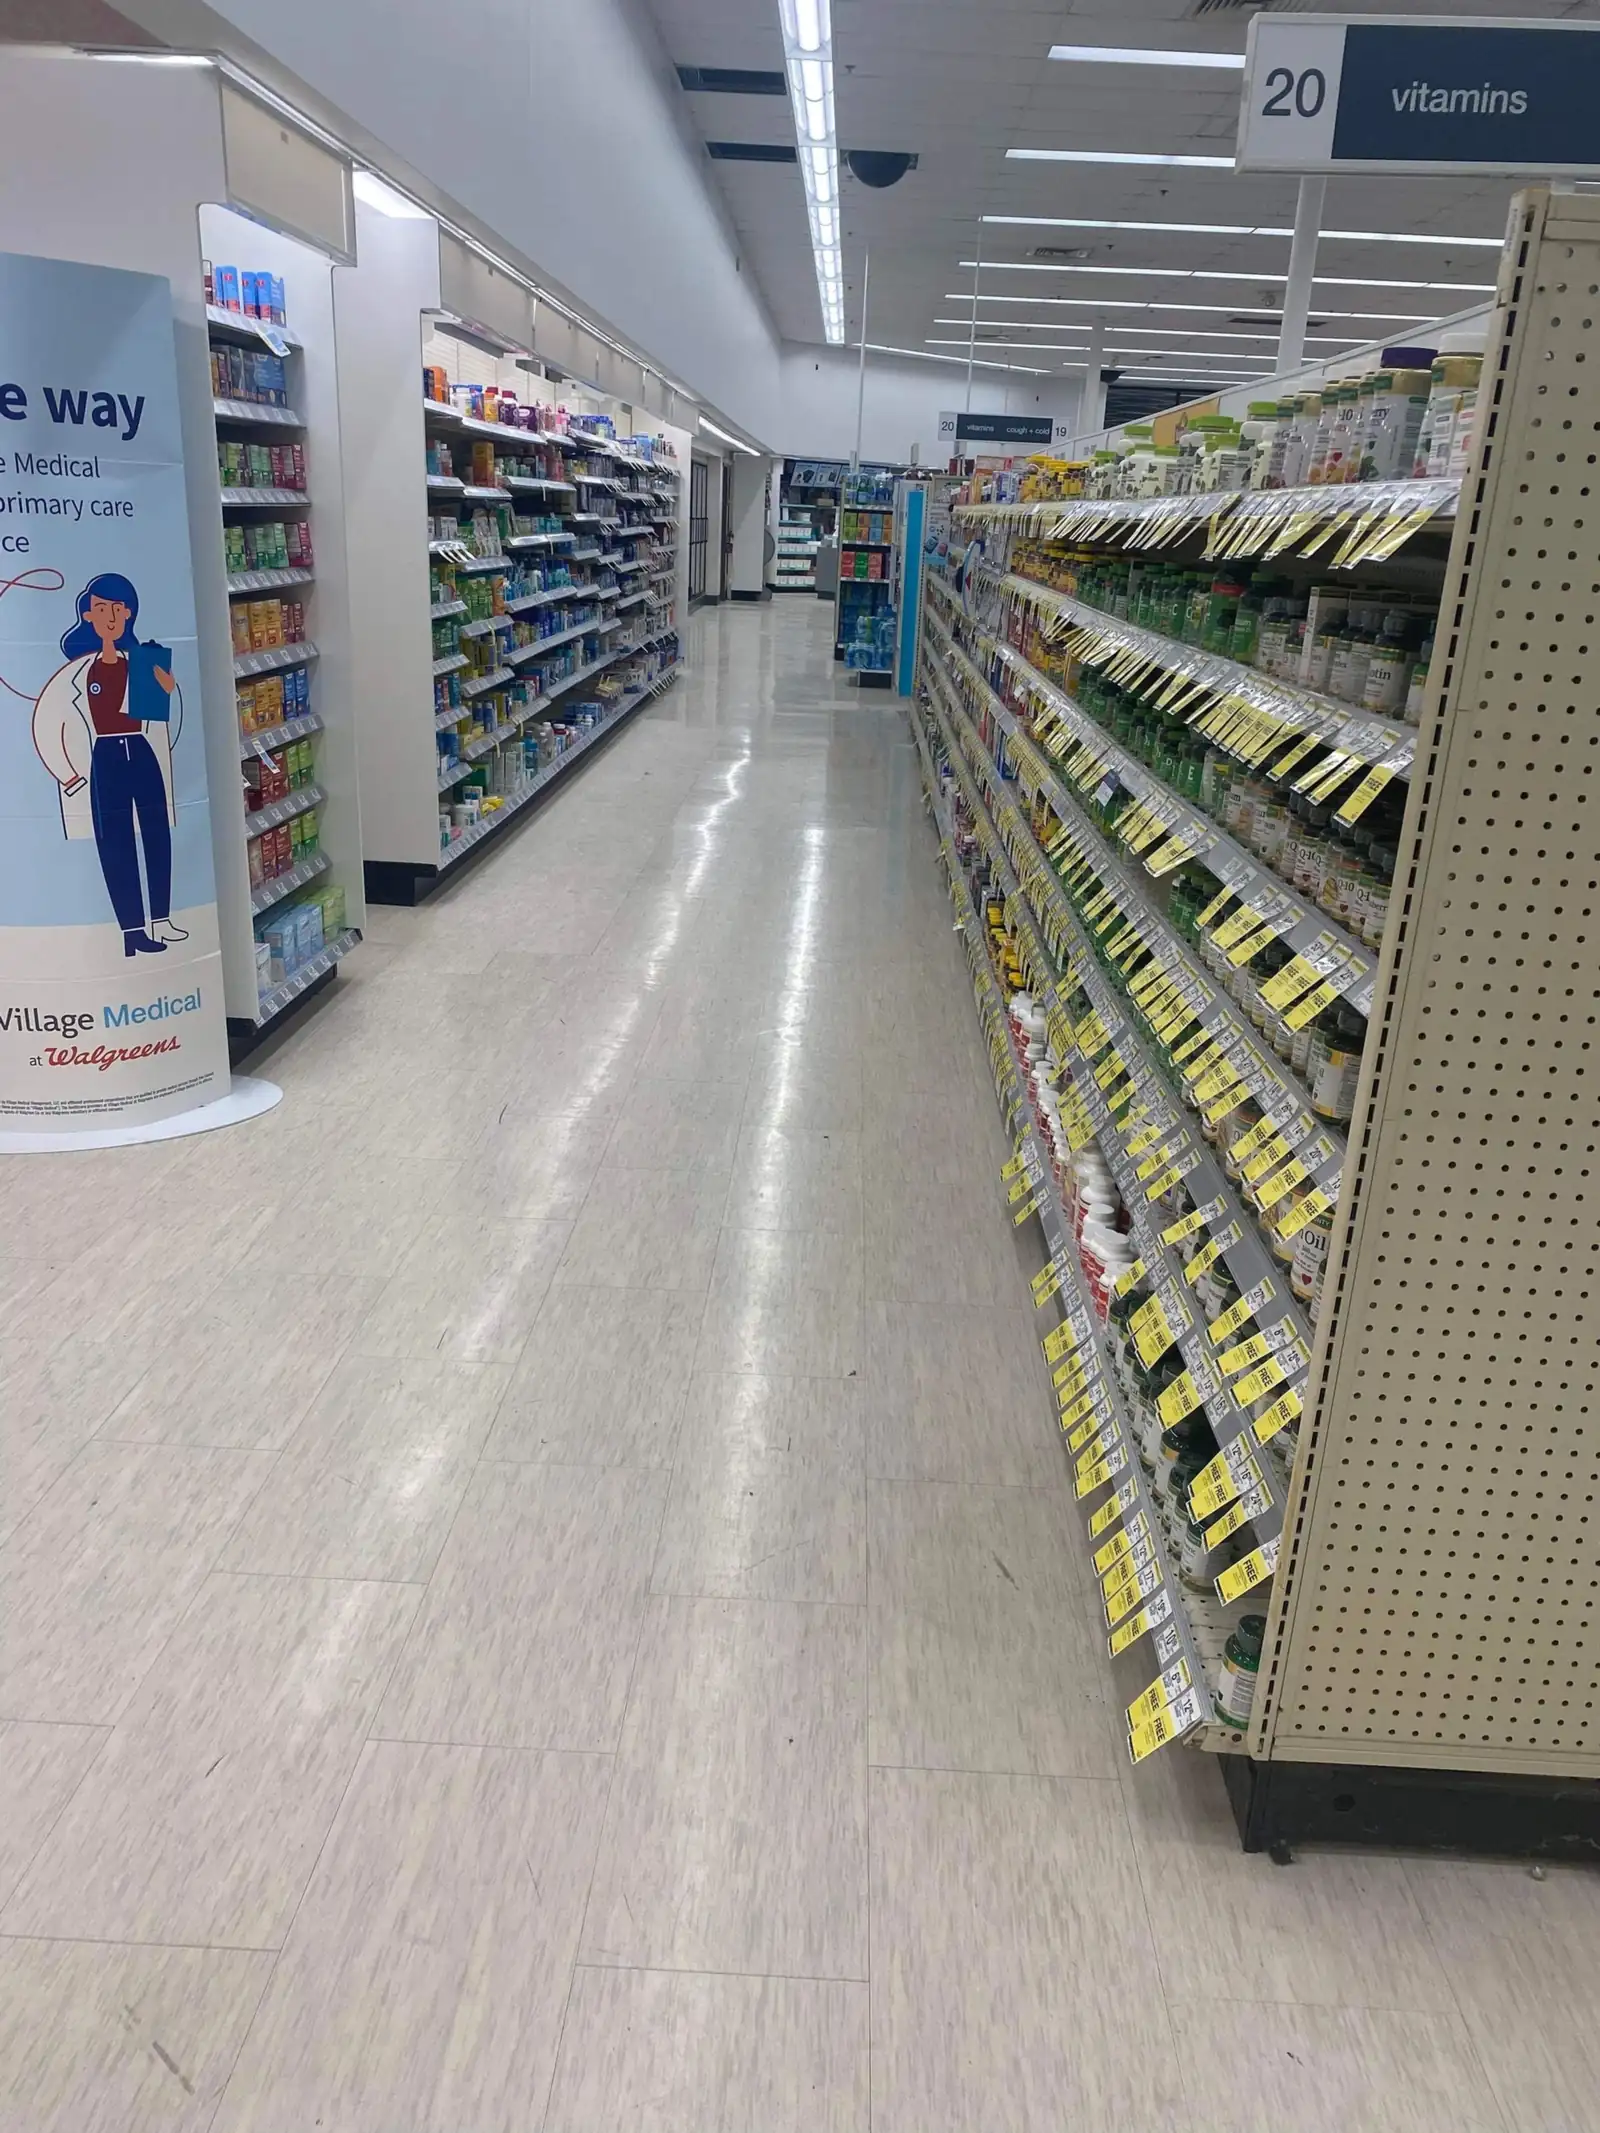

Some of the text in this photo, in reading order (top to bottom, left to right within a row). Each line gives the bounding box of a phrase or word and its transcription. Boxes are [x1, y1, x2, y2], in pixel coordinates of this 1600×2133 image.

[1261, 67, 1528, 118] 20 vitamins
[41, 385, 146, 442] way
[941, 421, 955, 432] 20
[966, 424, 995, 433] vitamins
[1006, 426, 1028, 435] cough
[1034, 427, 1050, 435] cold
[1055, 426, 1067, 437] 19
[15, 451, 101, 480] Medical
[90, 498, 135, 518] care
[0, 987, 202, 1039] Village Medical
[29, 1035, 182, 1072] at Walgreens
[1254, 1125, 1267, 1142] FREE
[1266, 1144, 1280, 1162] FREE
[1282, 1170, 1297, 1186] FREE
[1303, 1198, 1319, 1217] FREE
[1230, 1306, 1242, 1325] FREE
[1154, 1331, 1167, 1350] FREE
[1244, 1341, 1258, 1360] FREE
[1175, 1378, 1187, 1395] FREE
[1258, 1367, 1274, 1388] FREE
[1181, 1395, 1193, 1412] FREE
[1277, 1400, 1291, 1421] FREE
[1210, 1461, 1221, 1482] FREE
[1214, 1482, 1227, 1504] FREE
[1227, 1511, 1238, 1531] FREE
[1112, 1537, 1123, 1556] FREE
[1119, 1560, 1129, 1581] FREE
[1243, 1557, 1258, 1583] FREE
[1125, 1585, 1135, 1607] FREE
[1131, 1618, 1140, 1638] FREE
[1148, 1687, 1160, 1712] FREE
[1153, 1716, 1166, 1742] FREE
